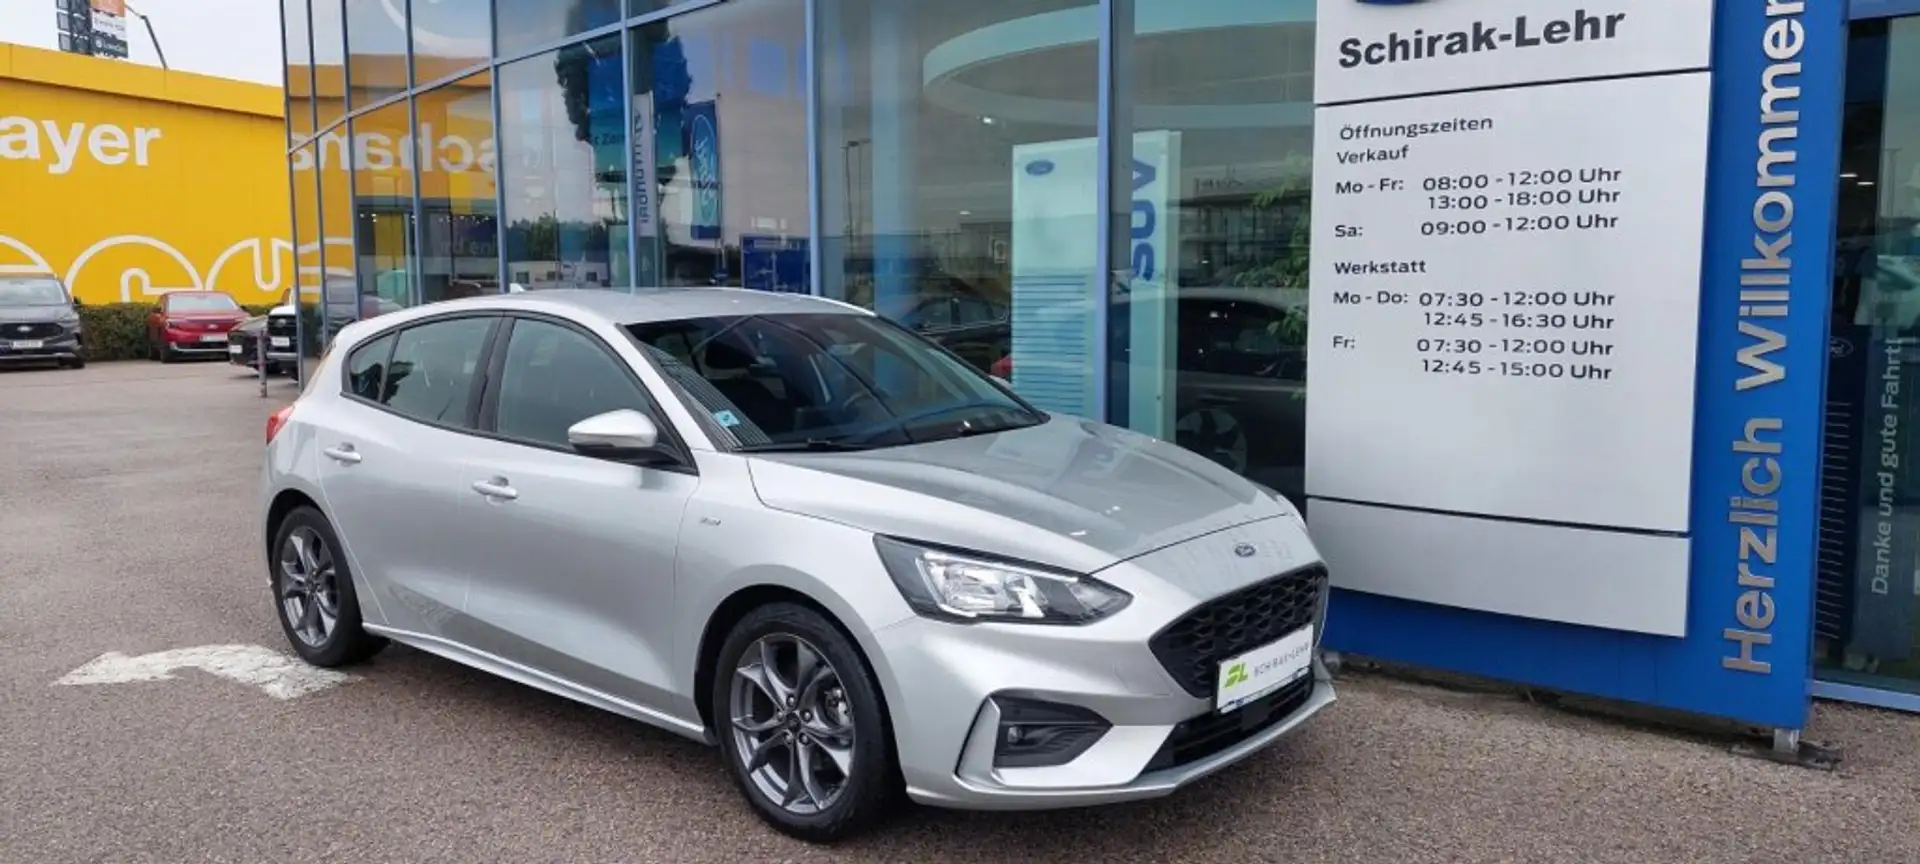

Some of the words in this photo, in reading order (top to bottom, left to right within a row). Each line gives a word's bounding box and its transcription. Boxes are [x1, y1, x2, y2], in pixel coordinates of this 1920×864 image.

[1338, 9, 1626, 69] Schirak-Lehr
[1339, 117, 1493, 141] Öffnungszeiten
[1336, 144, 1409, 165] Verkauf
[1335, 180, 1364, 195] Mo
[1379, 177, 1404, 192] Fr:
[1422, 174, 1489, 192] 08:00
[1507, 168, 1573, 187] 12:00
[1579, 167, 1622, 184] Uhr
[1428, 194, 1489, 210] 13:00
[1507, 189, 1572, 206] 18:00
[1578, 188, 1621, 204] Uhr
[1131, 158, 1157, 282] SUV
[1334, 224, 1364, 238] Sa:
[1420, 219, 1487, 236] 09:00
[1505, 215, 1570, 232] 12:00
[1576, 213, 1619, 230] Uhr
[1334, 259, 1427, 275] Werkstatt
[1333, 291, 1362, 305] Mo
[1376, 290, 1409, 304] Do:
[1418, 292, 1485, 307] 07:30
[1503, 290, 1567, 306] 12:00
[1573, 290, 1616, 307] Uhr
[1424, 311, 1484, 328] 12:45
[1502, 313, 1566, 329] 16:30
[1572, 313, 1615, 330] Uhr
[1332, 335, 1356, 350] Fr:
[1416, 338, 1482, 354] 07:30
[1501, 338, 1565, 354] 12:00
[1571, 340, 1615, 356] Uhr
[1422, 358, 1481, 375] 12:45
[1500, 361, 1564, 378] 15:00
[1570, 363, 1613, 380] Uhr
[1881, 338, 1902, 408] Fahrt!
[1880, 414, 1899, 468] gute
[1877, 471, 1895, 517] und
[1722, 417, 1783, 674] Herzlich
[1871, 521, 1892, 595] Danke
